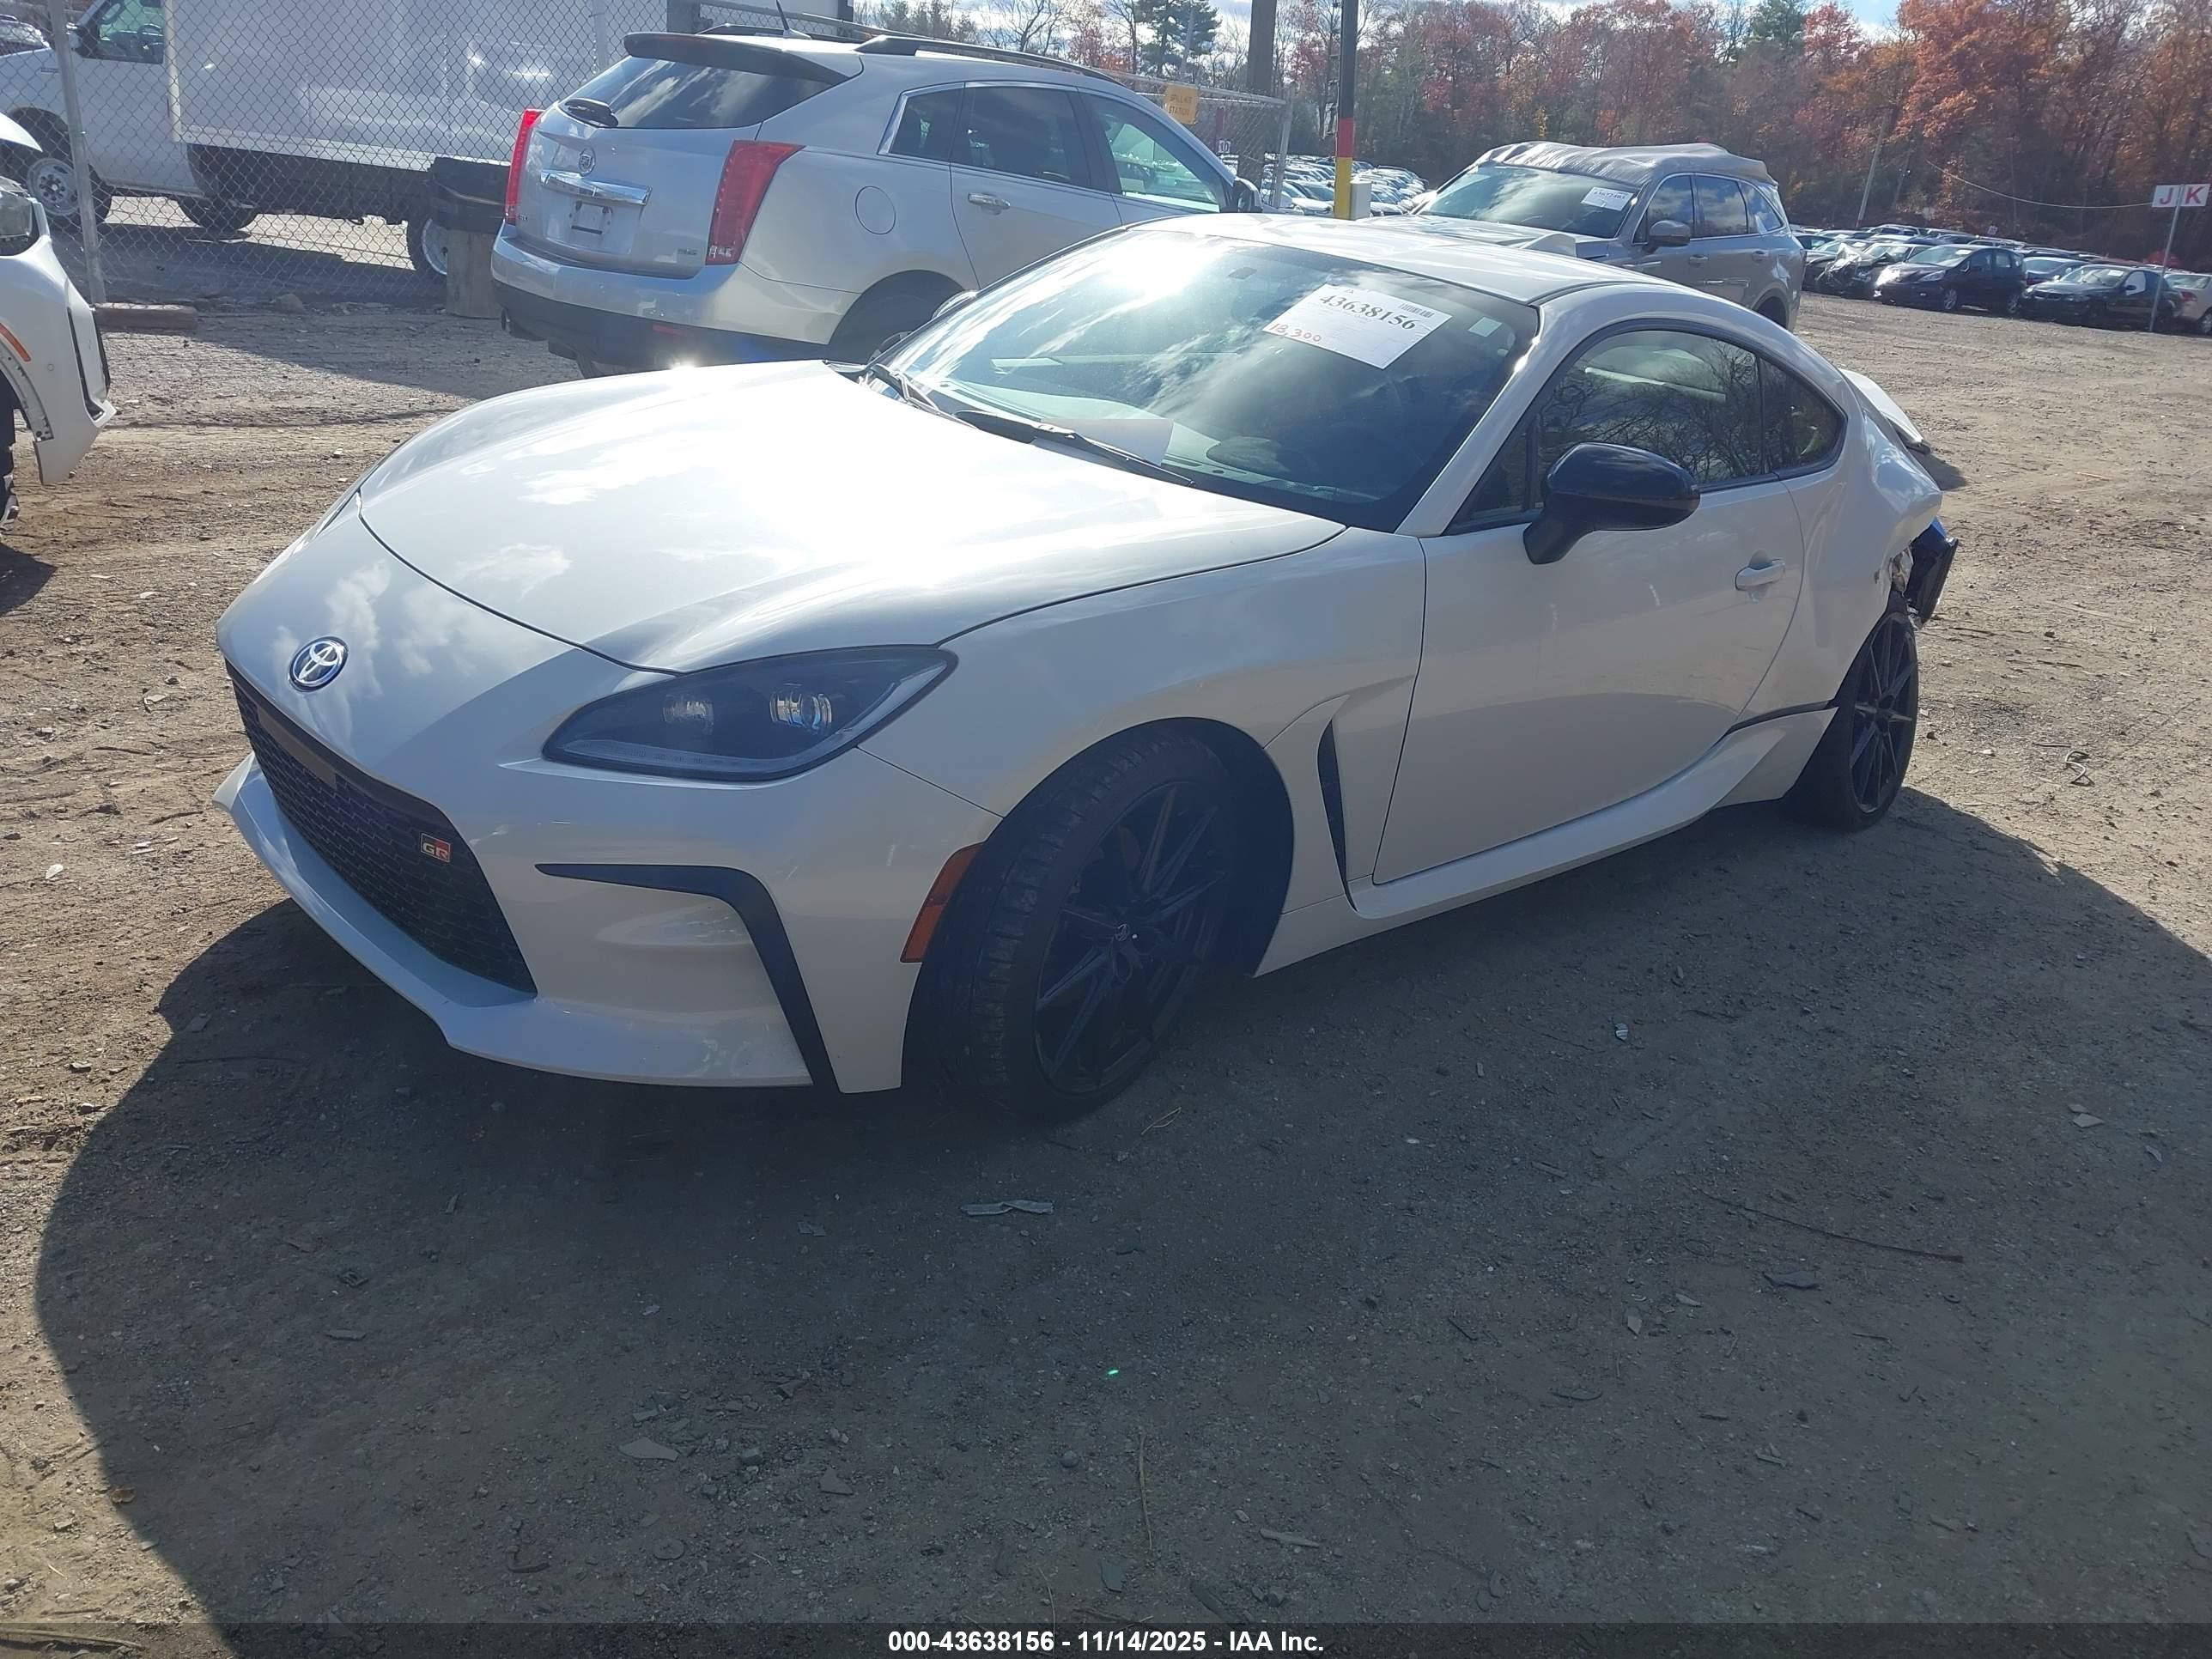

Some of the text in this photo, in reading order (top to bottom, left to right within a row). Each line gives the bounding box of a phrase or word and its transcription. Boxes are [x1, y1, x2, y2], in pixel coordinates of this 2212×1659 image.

[2160, 185, 2205, 204] J K
[1320, 294, 1421, 330] 43638156
[422, 842, 448, 860] GR
